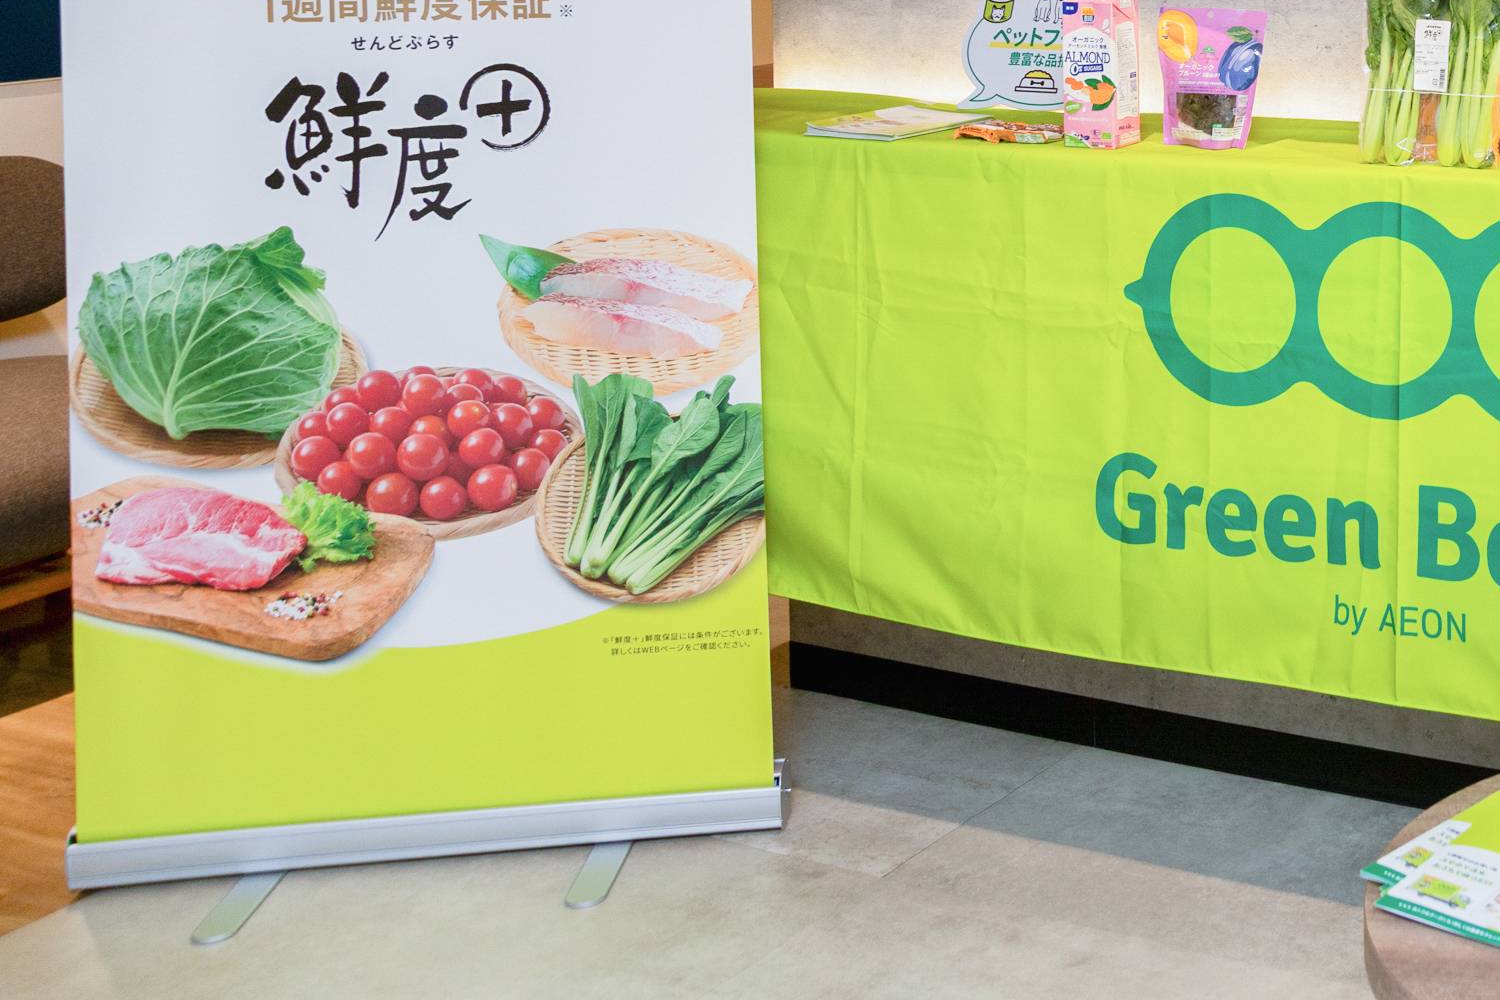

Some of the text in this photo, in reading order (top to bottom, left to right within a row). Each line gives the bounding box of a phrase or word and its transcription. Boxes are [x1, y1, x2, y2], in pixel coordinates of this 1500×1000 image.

[351, 34, 460, 51] せんどぷらす
[993, 27, 1063, 47] ペットフ
[1065, 51, 1111, 64] ALMOND
[1095, 451, 1382, 570] Green
[1332, 594, 1467, 643] by AEON
